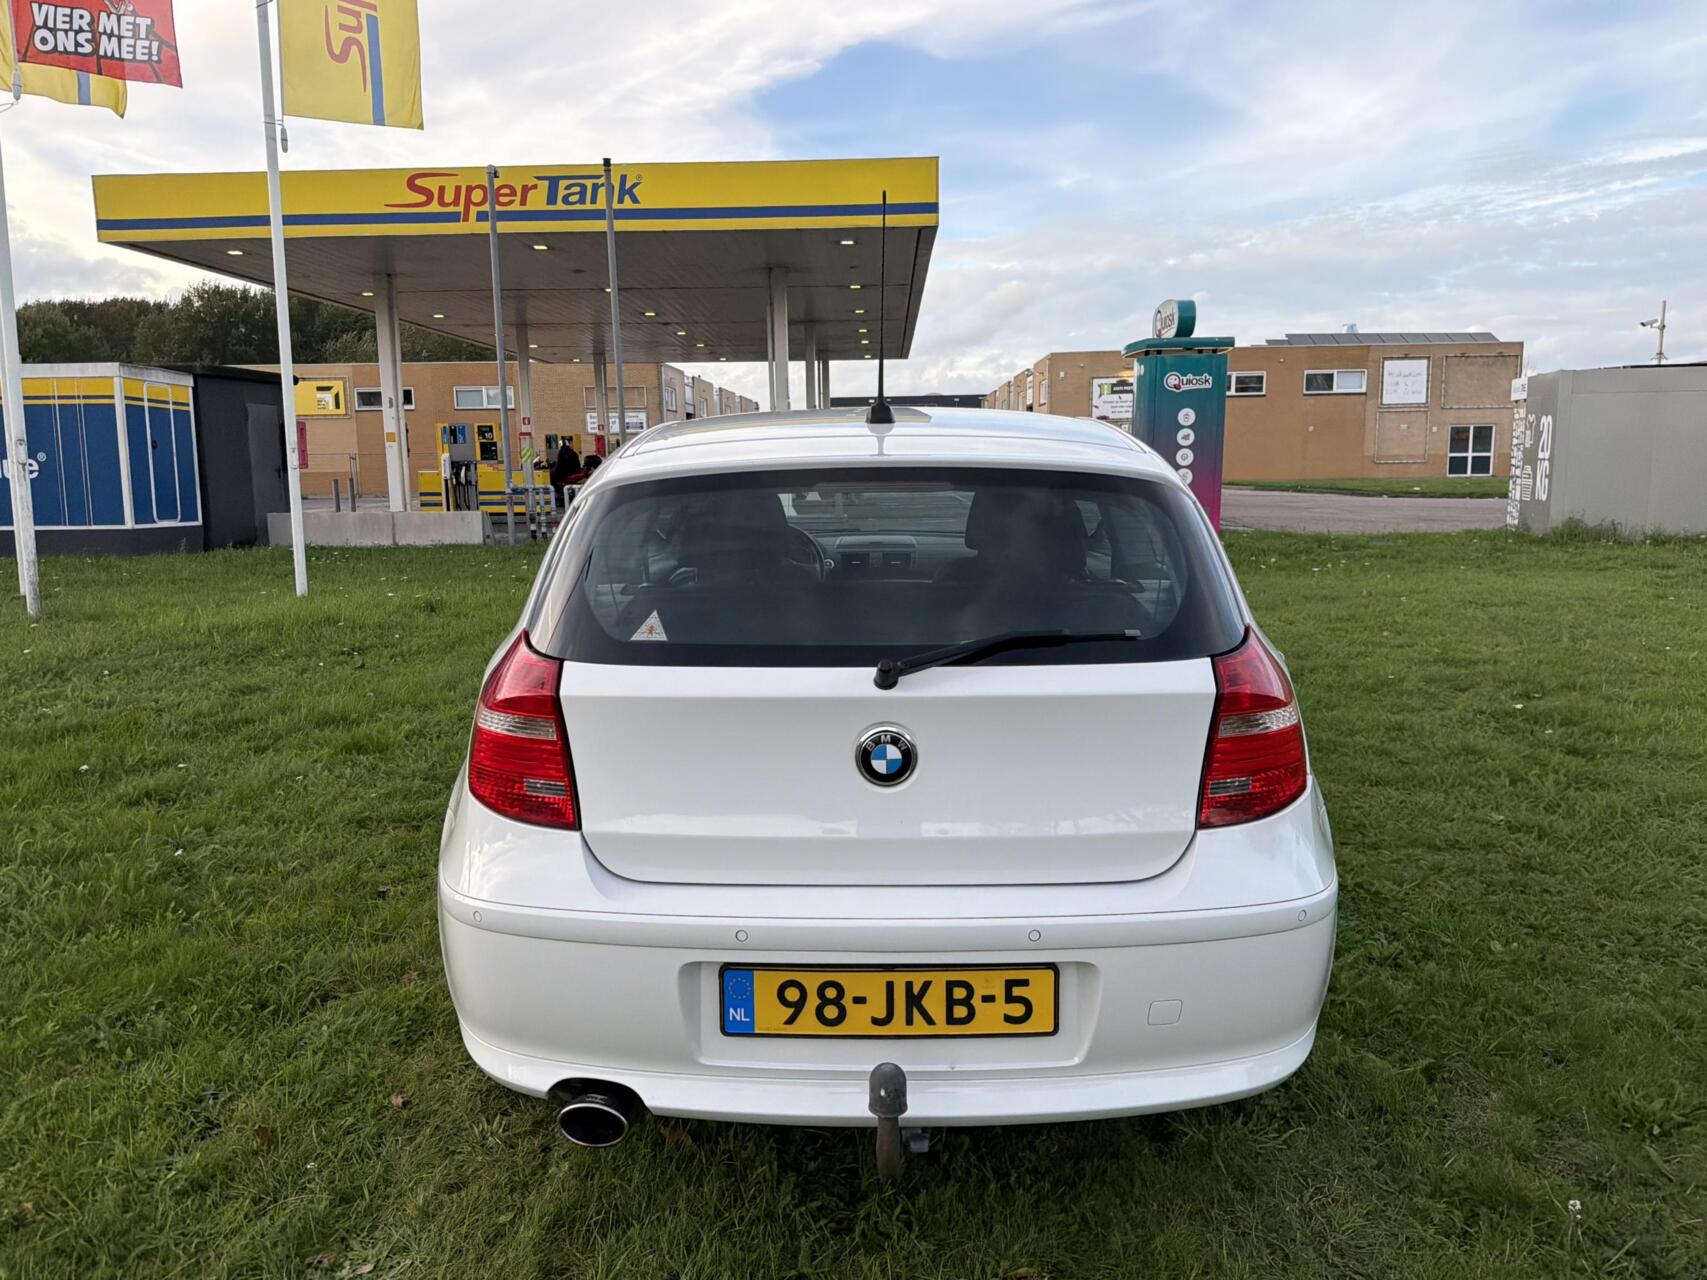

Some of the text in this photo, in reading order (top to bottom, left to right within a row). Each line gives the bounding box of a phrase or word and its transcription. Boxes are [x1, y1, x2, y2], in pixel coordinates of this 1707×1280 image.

[31, 3, 151, 38] VIER MET
[34, 28, 159, 60] ONS MEE!
[1165, 373, 1211, 390] Quiosk
[1538, 415, 1553, 459] 20
[1535, 460, 1549, 501] KG
[865, 734, 908, 751] BMW
[729, 1007, 750, 1021] NL
[776, 978, 1034, 1027] 98-JKB-5
